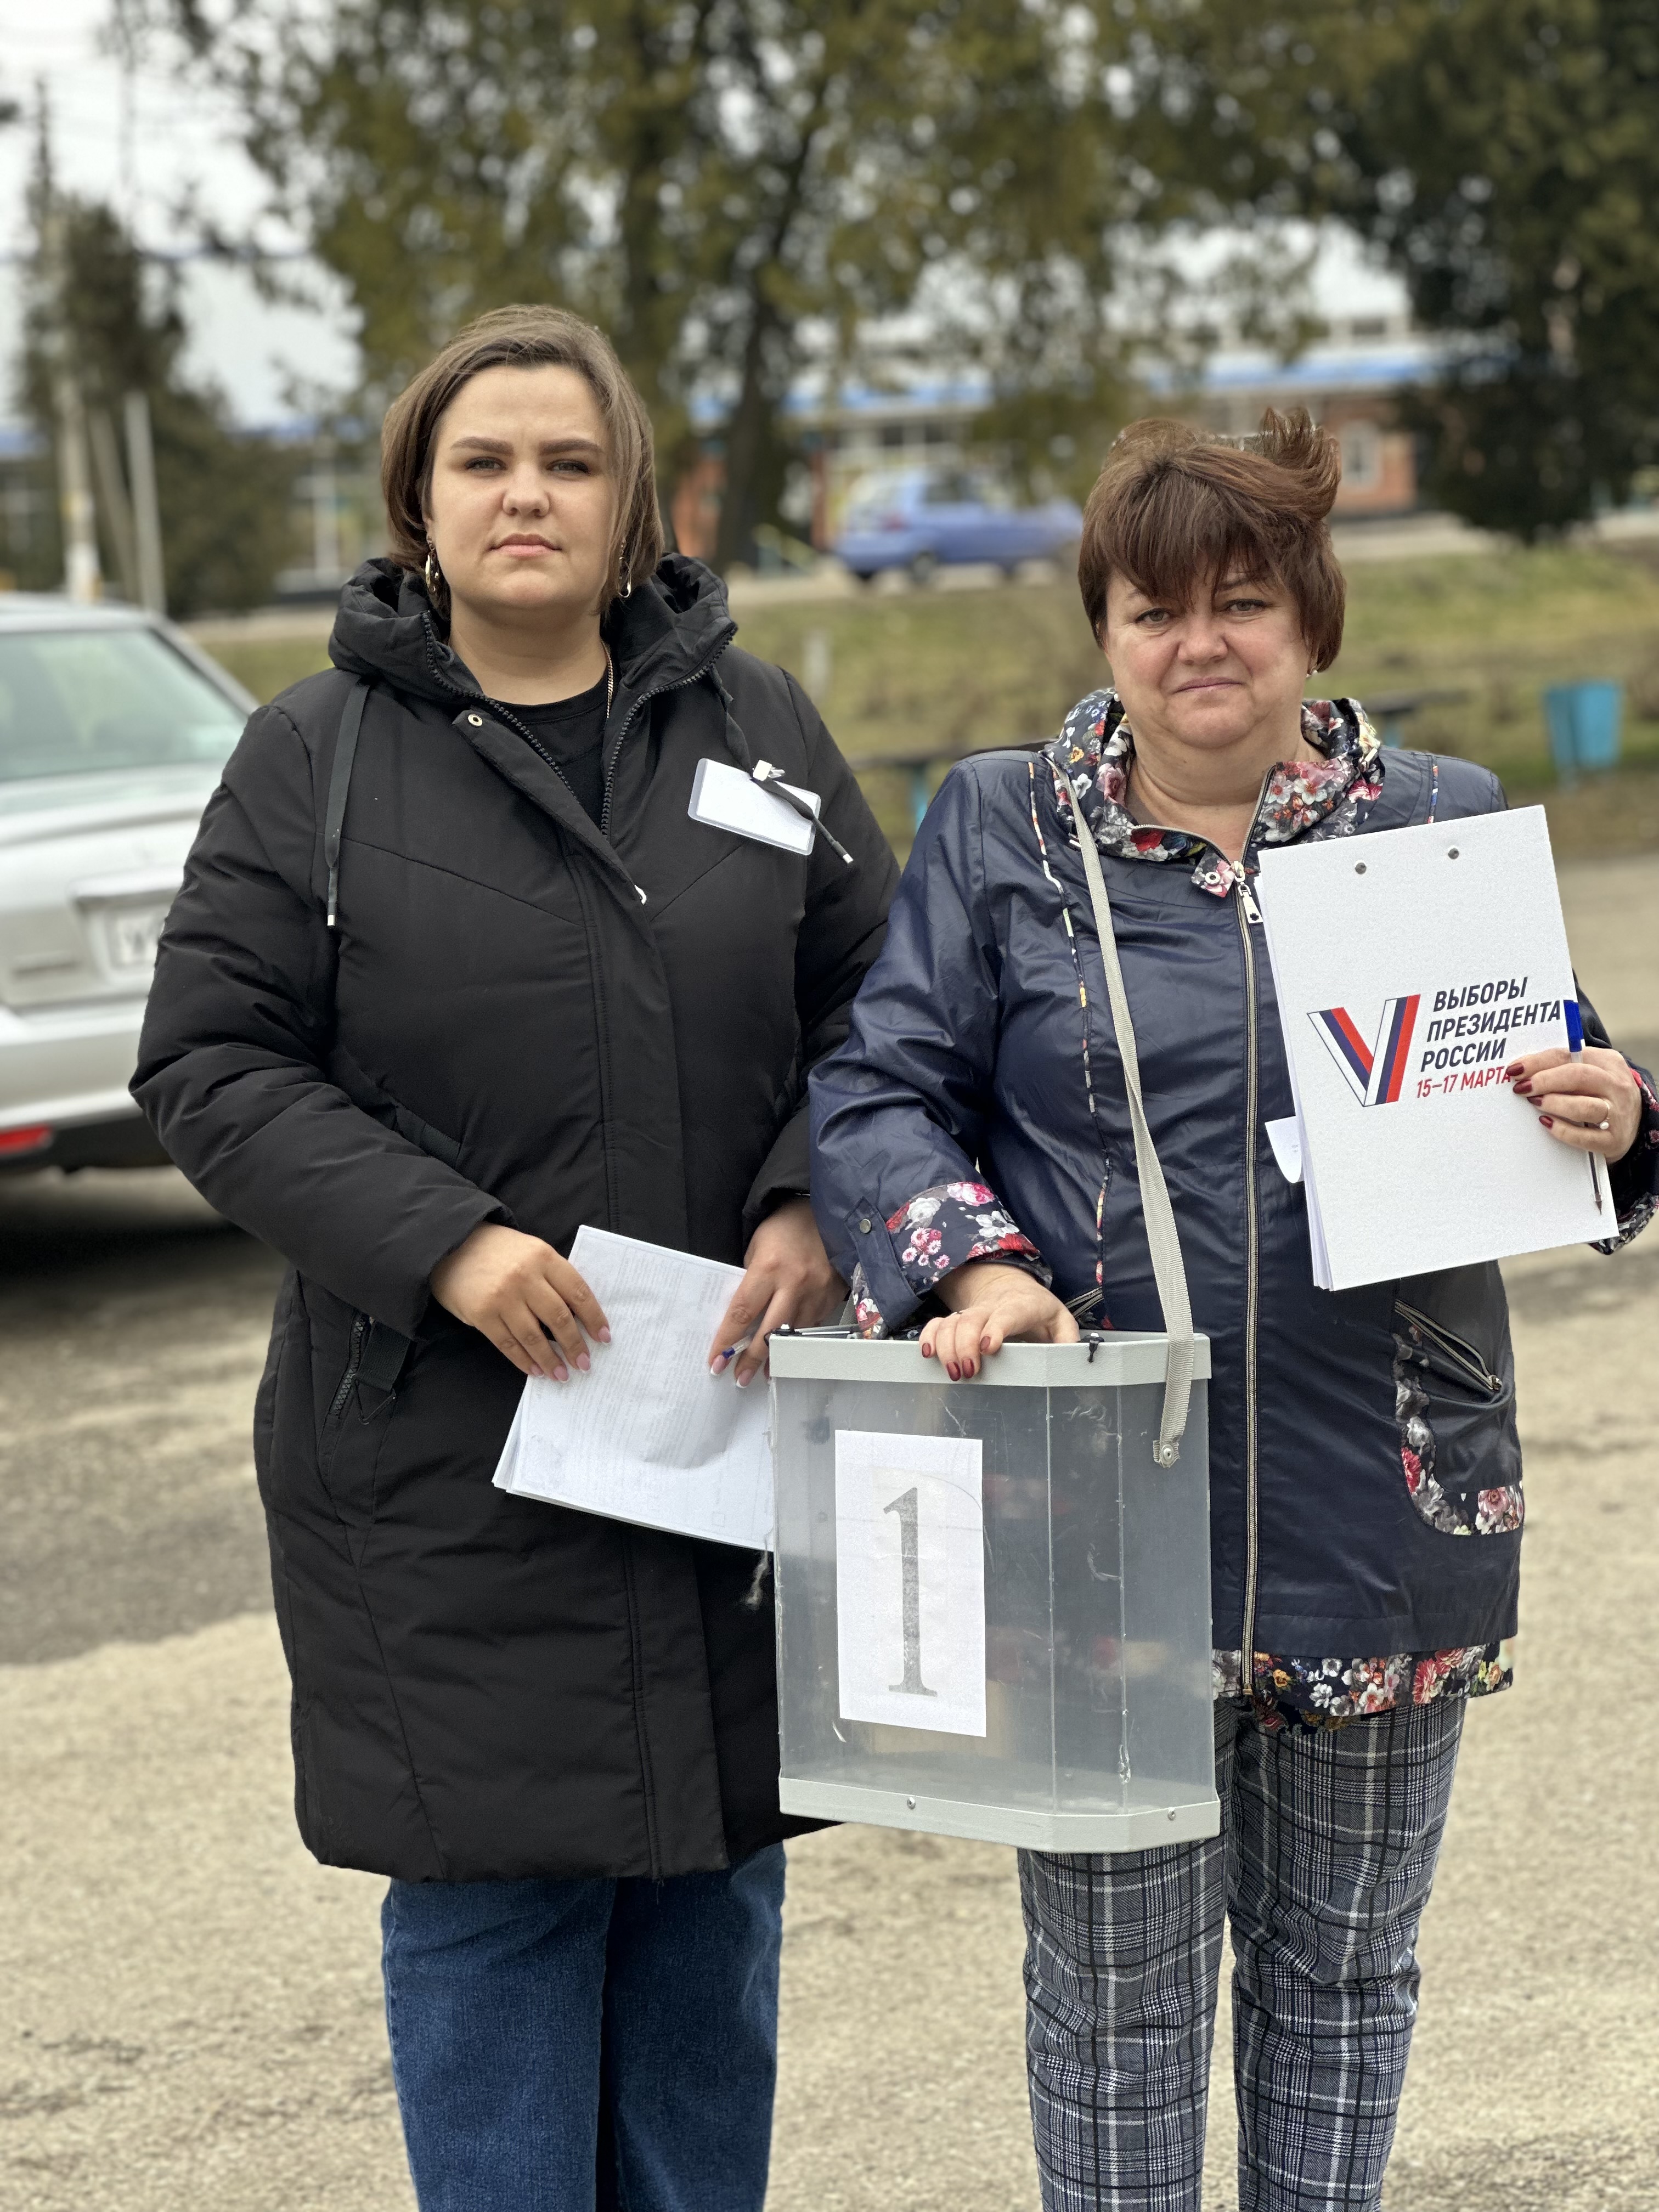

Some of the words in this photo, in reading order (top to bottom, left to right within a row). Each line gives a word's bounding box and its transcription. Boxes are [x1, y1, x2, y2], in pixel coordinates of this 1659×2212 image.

[1433, 977, 1528, 1013] ВЫБОРЫ
[1426, 1000, 1560, 1042] ПРЕЗИДЕНТА
[1420, 1038, 1507, 1073] РОССИИ
[883, 1487, 938, 1697] 1
